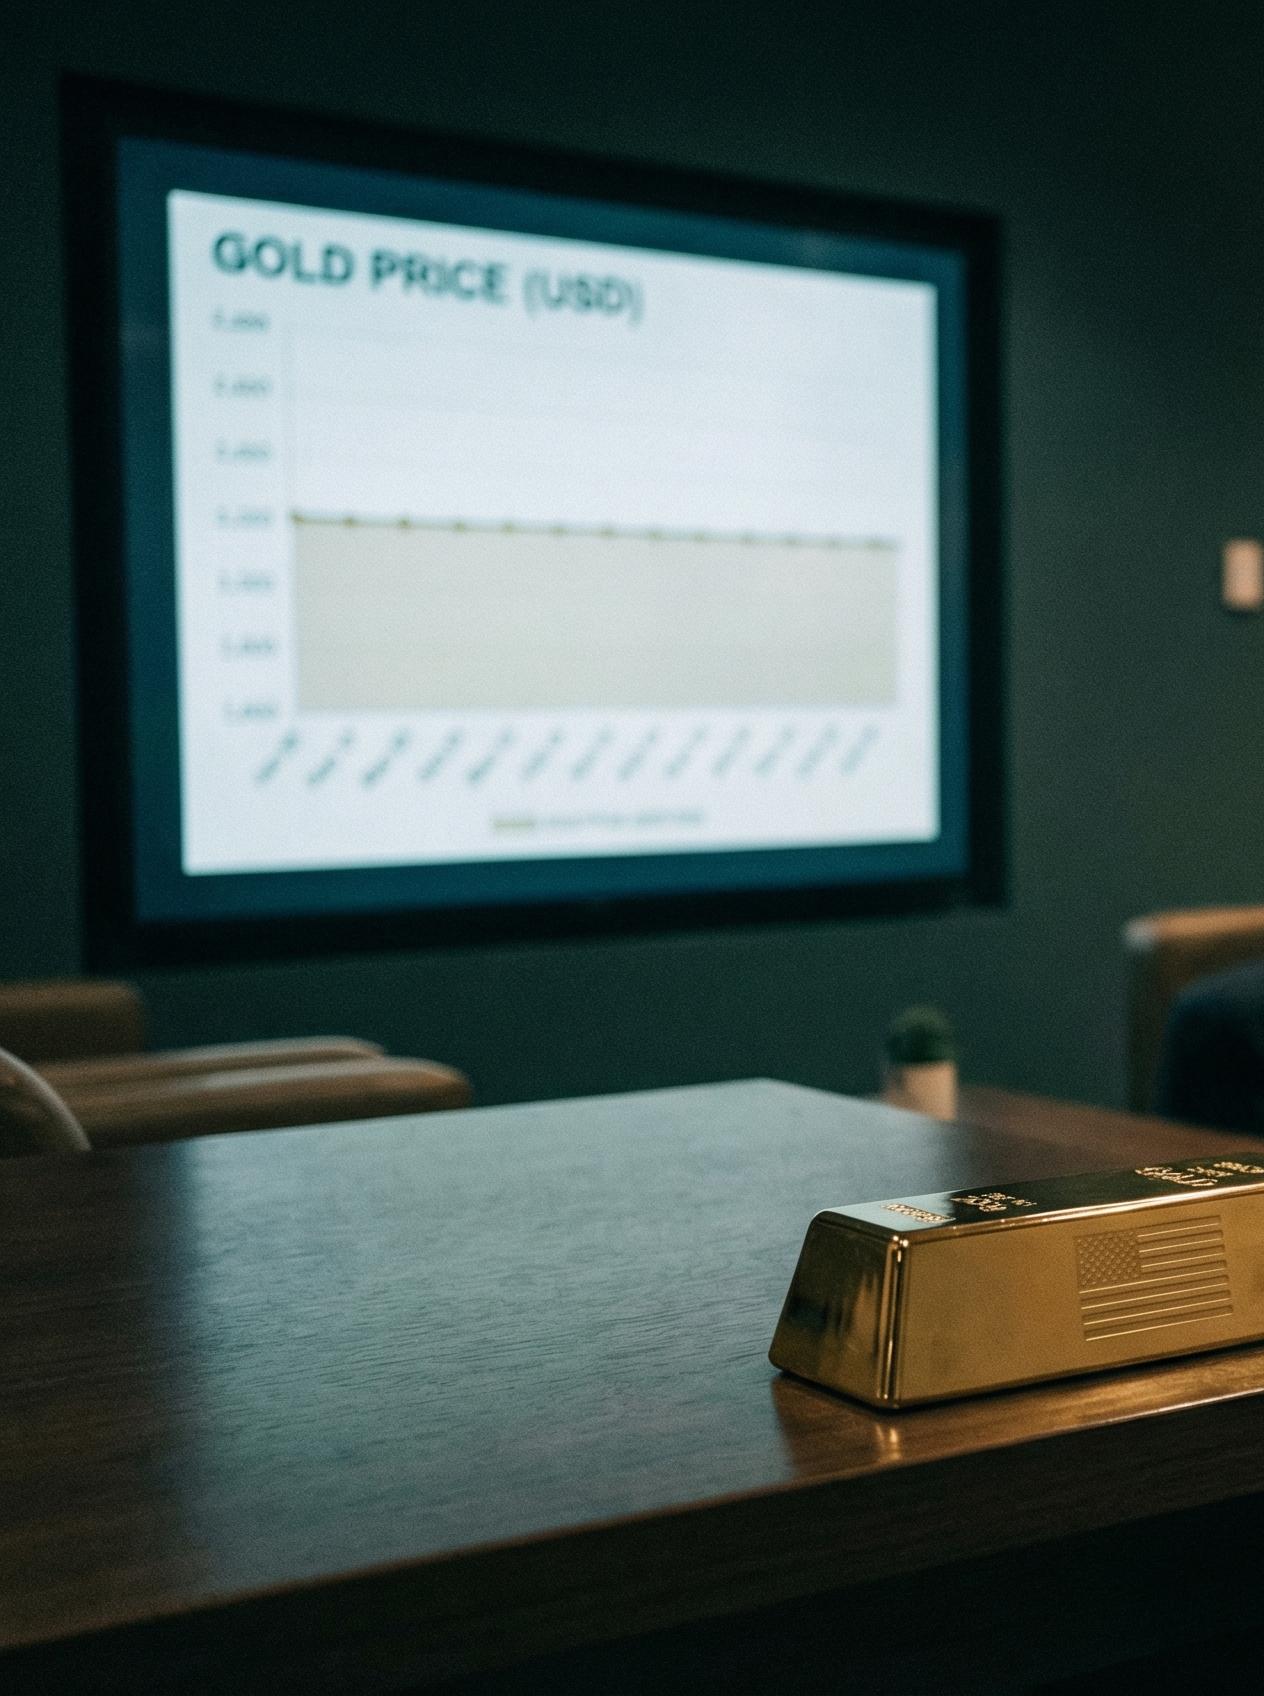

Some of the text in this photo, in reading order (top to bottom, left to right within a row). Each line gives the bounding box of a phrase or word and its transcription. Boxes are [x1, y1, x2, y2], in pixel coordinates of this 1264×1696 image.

[213, 232, 645, 328] GOLD PRICE (USD)
